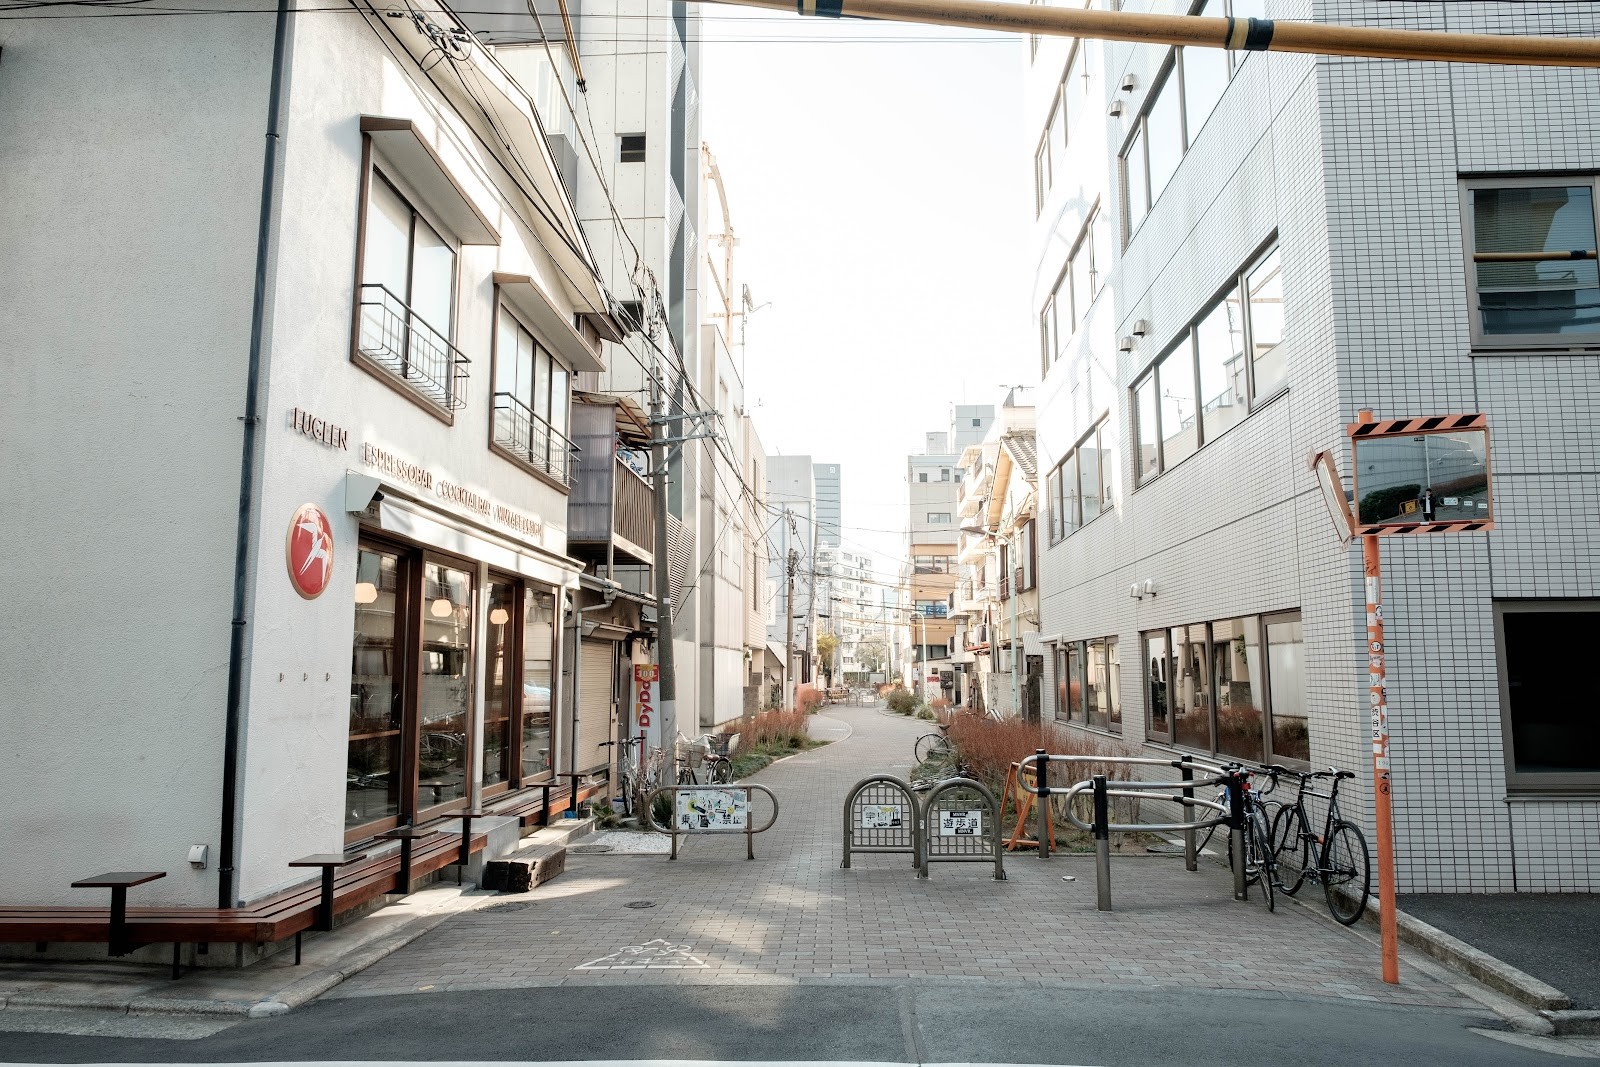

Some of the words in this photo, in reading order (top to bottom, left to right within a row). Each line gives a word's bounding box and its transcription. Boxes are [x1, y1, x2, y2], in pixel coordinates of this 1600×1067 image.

[292, 407, 347, 451] FUGLEN
[943, 818, 979, 829] 遊歩道
